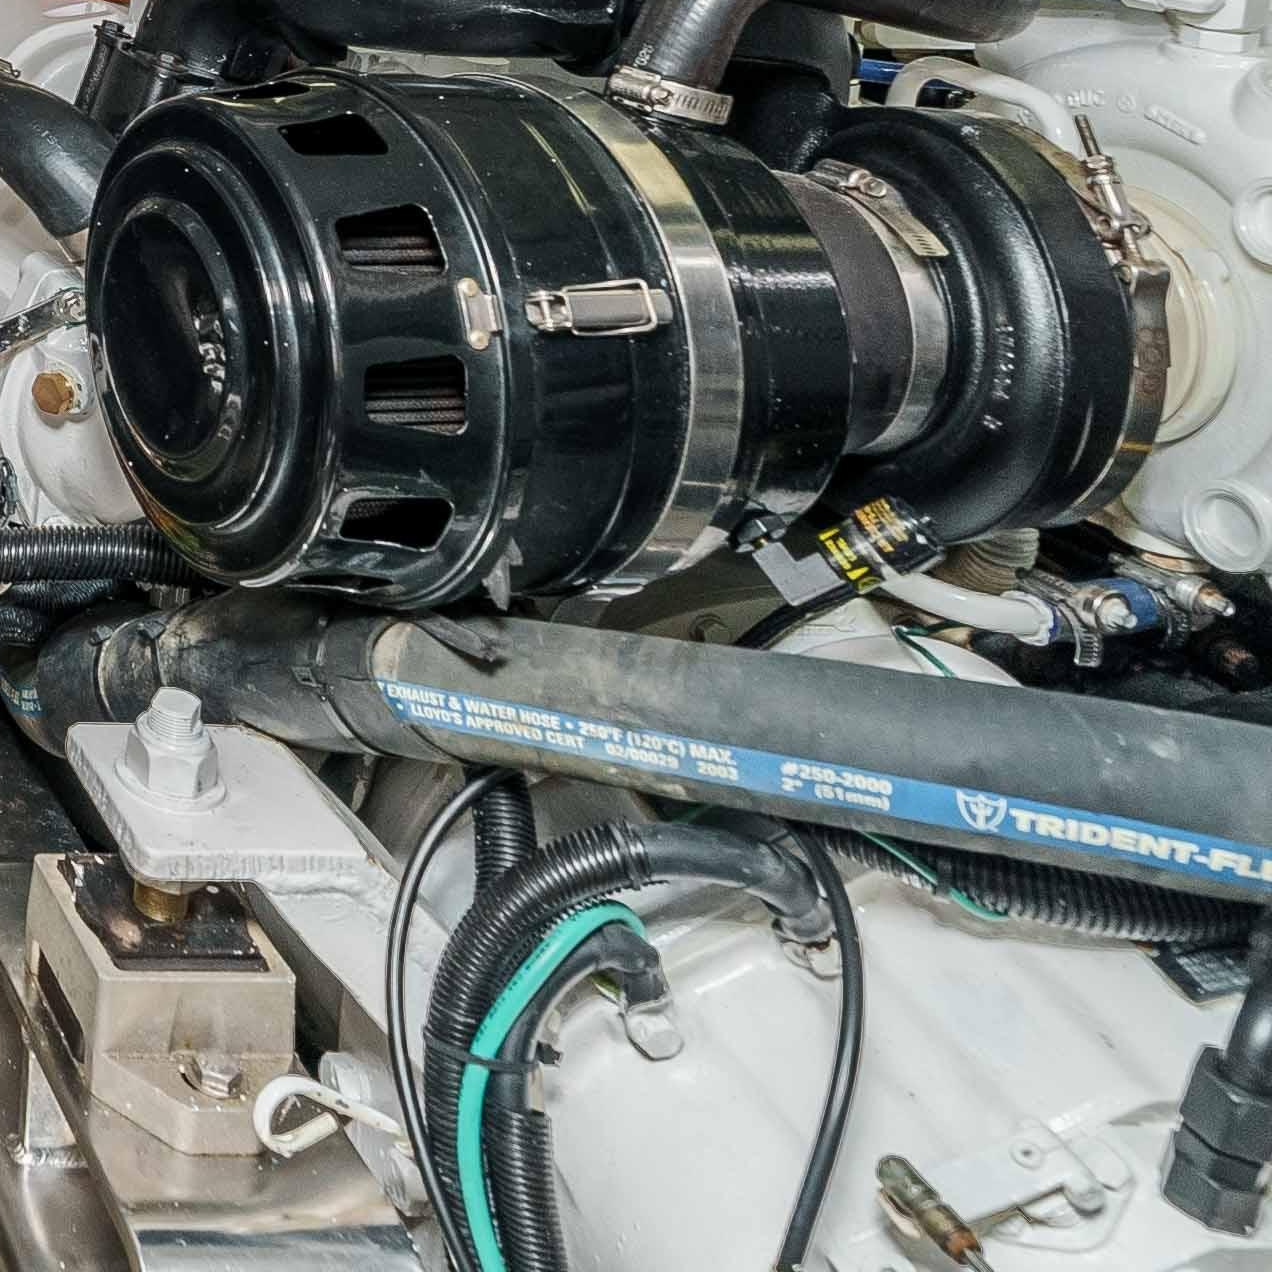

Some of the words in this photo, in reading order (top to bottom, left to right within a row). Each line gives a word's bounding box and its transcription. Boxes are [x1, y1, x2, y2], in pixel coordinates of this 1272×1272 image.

[387, 687, 447, 707] EXHAUST
[449, 696, 460, 711] &
[463, 698, 517, 722] WATER
[520, 710, 562, 731] HOSE
[464, 713, 544, 744] APPROVED
[545, 729, 585, 750] CERT
[696, 760, 739, 781] 2003
[779, 761, 893, 796] #250-2000
[814, 784, 891, 812] (51mm)
